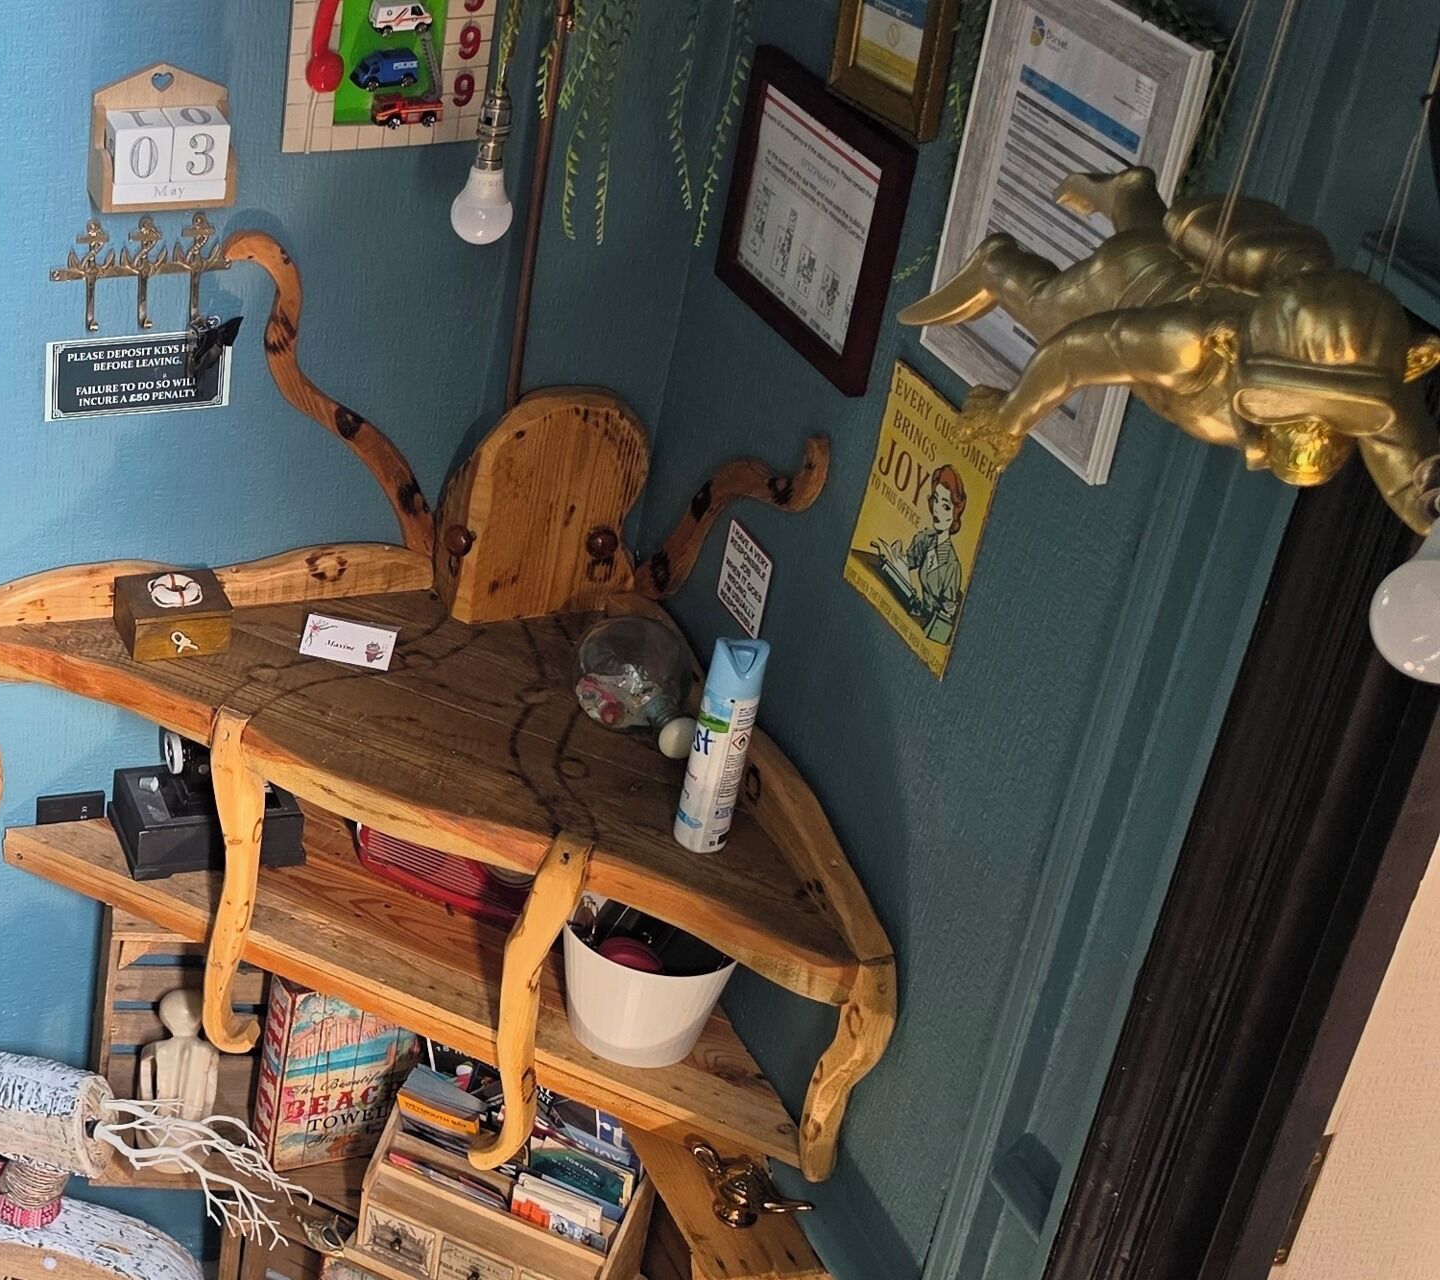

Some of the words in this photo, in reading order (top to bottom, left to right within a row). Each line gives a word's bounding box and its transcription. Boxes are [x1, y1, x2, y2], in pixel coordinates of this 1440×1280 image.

[393, 61, 418, 70] POLICE
[154, 185, 185, 198] May
[68, 351, 104, 362] PLEASE
[106, 347, 152, 359] DEPOSIT
[154, 344, 179, 355] KEYS
[93, 360, 134, 371] BEFORE
[136, 356, 182, 368] LEAVING.
[76, 384, 118, 395] FAILURE
[120, 383, 136, 392] TO
[137, 381, 154, 390] DO
[156, 379, 170, 388] SO
[79, 395, 118, 406] INCURE
[120, 394, 127, 403] A
[129, 393, 150, 402] £50
[152, 388, 198, 401] PENALTY
[893, 410, 938, 462] BRINGS
[895, 377, 933, 420] EVERY
[934, 413, 996, 482] CUSOMER
[878, 439, 931, 507] JOY
[871, 473, 880, 489] TO
[882, 483, 897, 506] THIS
[897, 500, 921, 528] OFFICE
[730, 536, 766, 582] RESPONSIBLE
[735, 528, 749, 550] HAVE
[754, 550, 769, 569] VERY
[726, 557, 741, 579] WHEN
[747, 582, 762, 603] GOES
[740, 562, 751, 578] JOB
[720, 588, 755, 634] RESPONSIBLE
[731, 590, 755, 620] USUALLY
[325, 639, 356, 651] Maxine
[404, 1101, 450, 1124] WEYMOUTH
[451, 1119, 467, 1129] BAY
